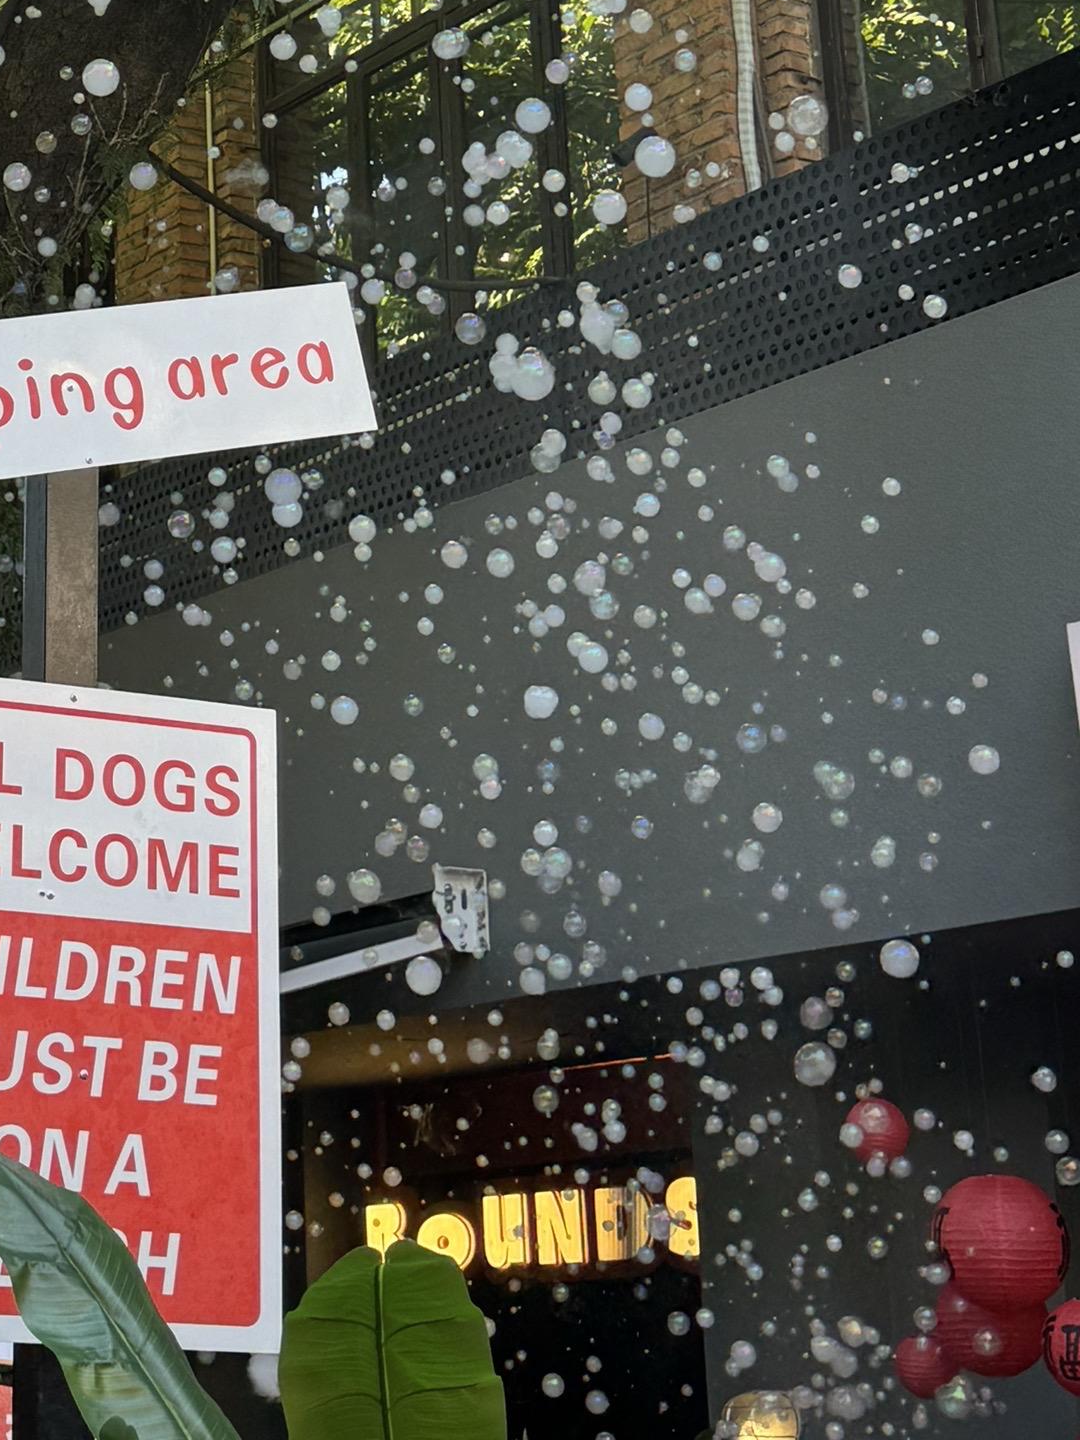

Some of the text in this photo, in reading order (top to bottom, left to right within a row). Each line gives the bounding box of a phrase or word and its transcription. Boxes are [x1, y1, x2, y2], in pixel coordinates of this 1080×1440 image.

[167, 341, 334, 401] area
[55, 747, 241, 817] DOGS
[137, 1039, 223, 1106] BE
[104, 1133, 151, 1197] A
